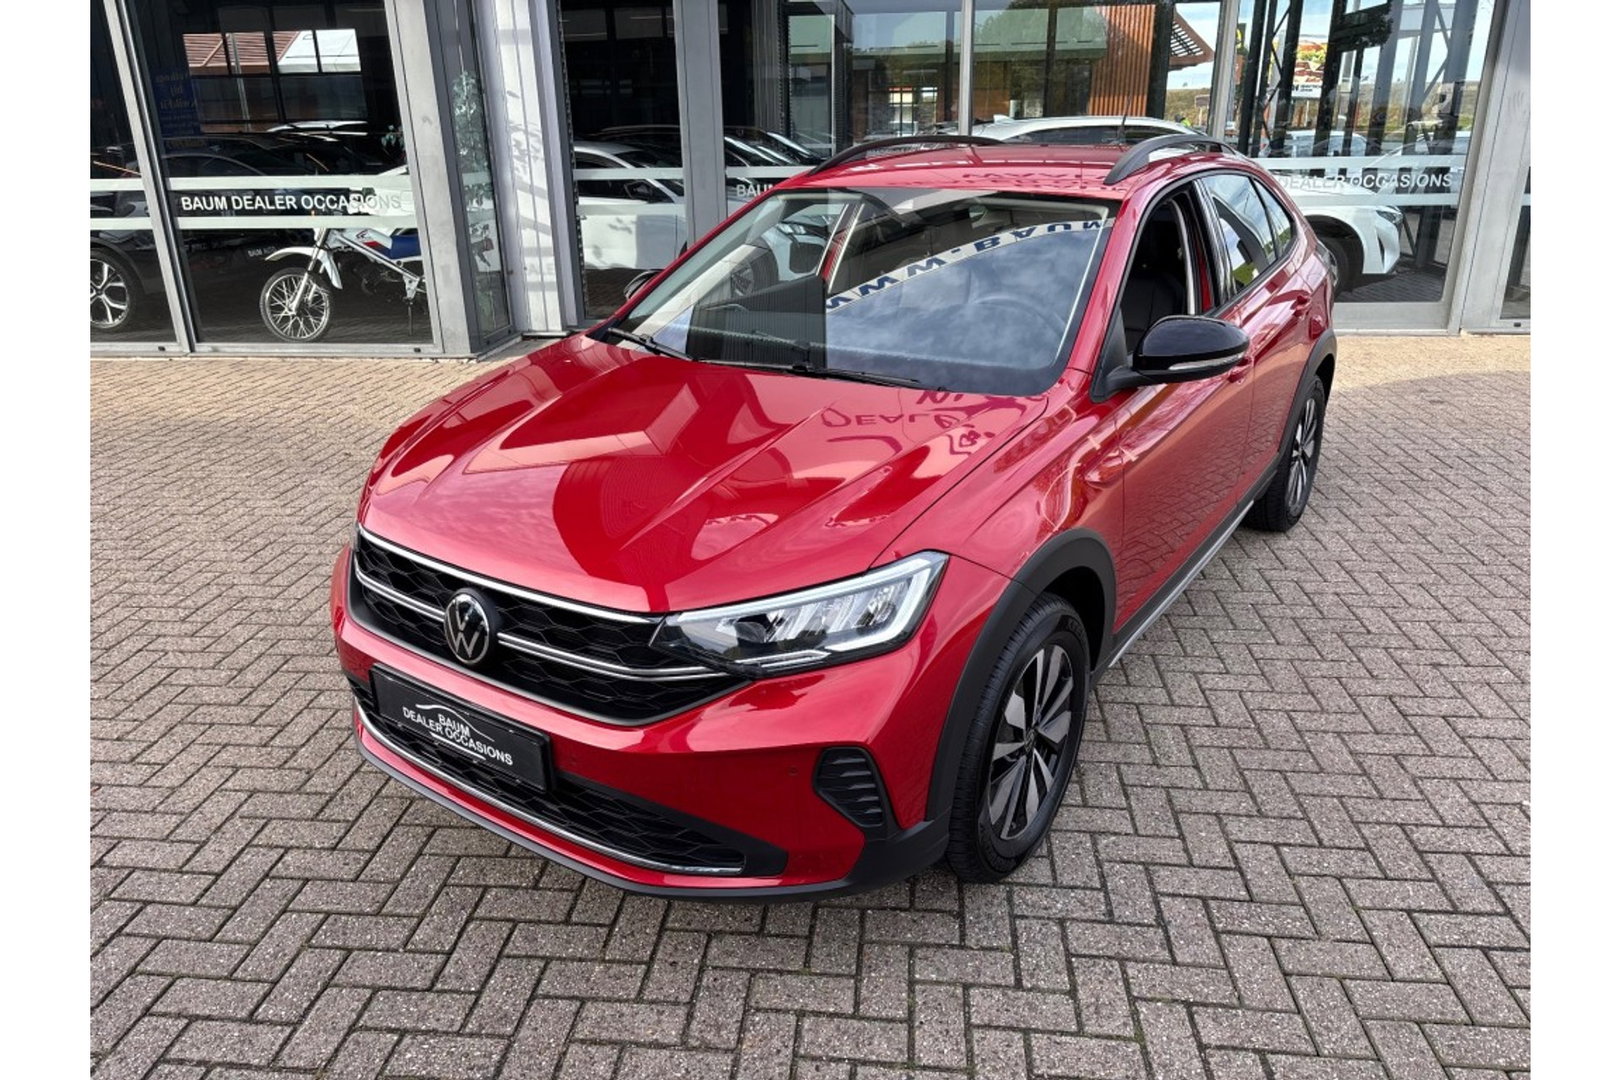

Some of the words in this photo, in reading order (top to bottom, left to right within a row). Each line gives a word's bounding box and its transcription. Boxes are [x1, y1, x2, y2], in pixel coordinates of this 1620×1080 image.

[736, 184, 774, 197] BAU
[1351, 174, 1453, 189] OCCASIONS
[180, 196, 227, 212] BAUM
[231, 195, 298, 211] DEALER
[301, 194, 402, 210] OCCASIONS
[443, 589, 489, 664] VW
[402, 706, 444, 736] DEALER
[443, 727, 513, 766] OCCASIONS
[437, 713, 471, 738] BAUM
